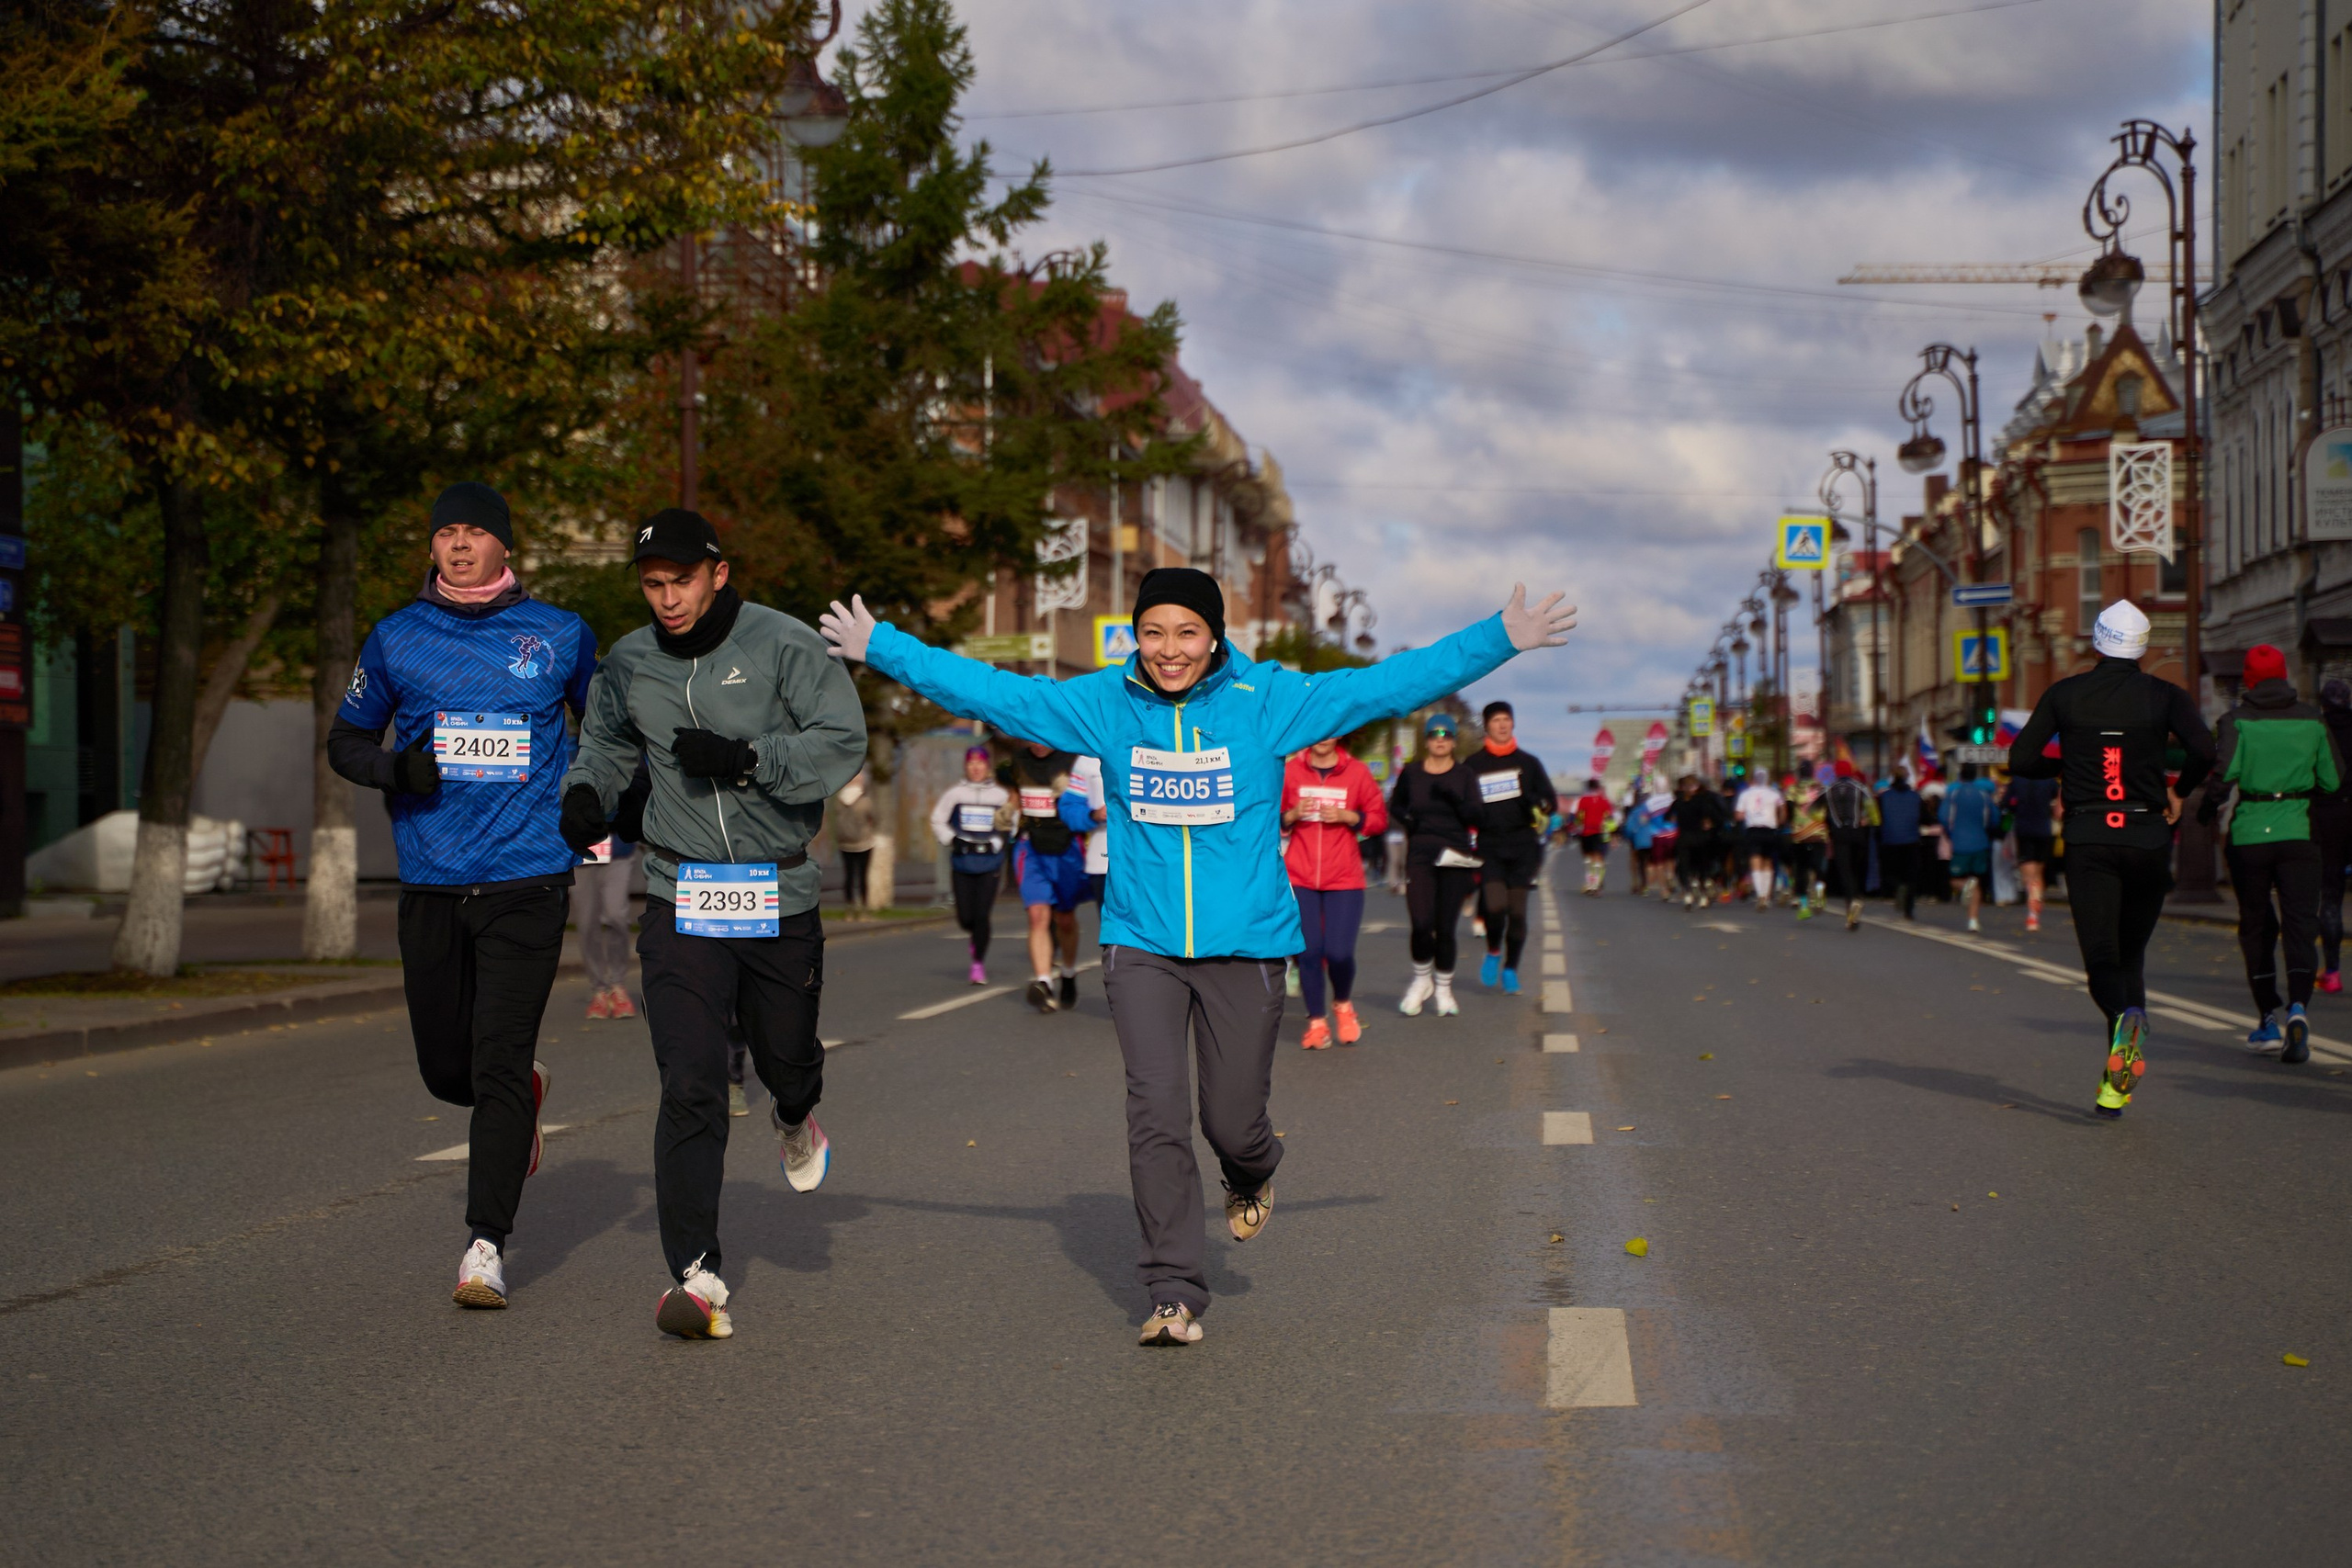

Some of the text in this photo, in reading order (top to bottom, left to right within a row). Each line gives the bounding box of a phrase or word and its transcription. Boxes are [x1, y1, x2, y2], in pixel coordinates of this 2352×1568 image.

[453, 737, 510, 758] 2402
[1195, 757, 1209, 765] 21,1
[1149, 776, 1211, 800] 2605
[749, 869, 757, 877] 10
[698, 890, 756, 911] 2393
